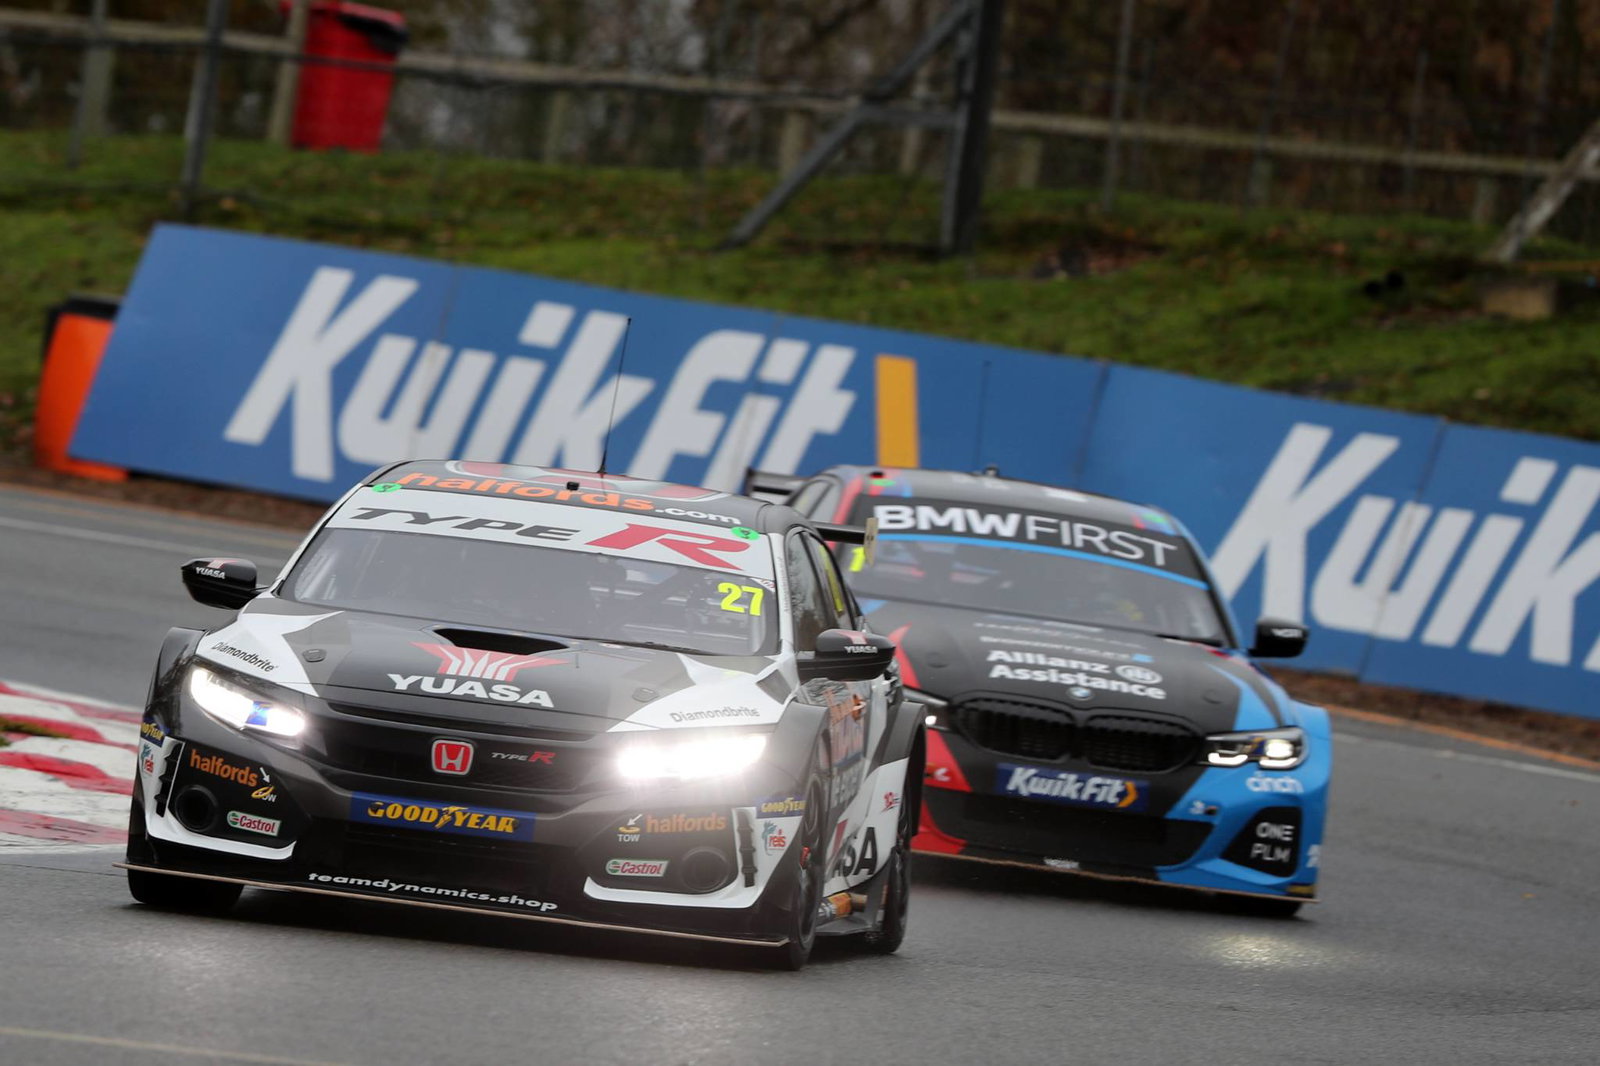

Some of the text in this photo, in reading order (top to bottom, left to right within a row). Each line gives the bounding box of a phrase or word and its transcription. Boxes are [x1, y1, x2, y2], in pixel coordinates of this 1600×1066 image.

[351, 507, 750, 571] TYPE R
[1204, 422, 1600, 675] Kwik
[195, 566, 226, 579] YUASA
[716, 582, 763, 616] 27
[211, 642, 274, 672] Diamondbrite
[986, 650, 1112, 674] Allianz
[386, 673, 555, 709] YUASA
[988, 664, 1167, 699] Assistance
[669, 706, 761, 723] Diamondbrite
[189, 748, 259, 787] halfords
[491, 751, 557, 765] TYPE R
[1245, 770, 1304, 793] cinch
[239, 815, 276, 833] Castrol
[366, 801, 516, 834] GOODYEAR
[645, 812, 727, 834] halfords
[617, 834, 640, 843] TOW
[1255, 821, 1295, 842] ONE
[619, 861, 663, 875] Castrol
[308, 872, 558, 913] teamdynamics.shop
